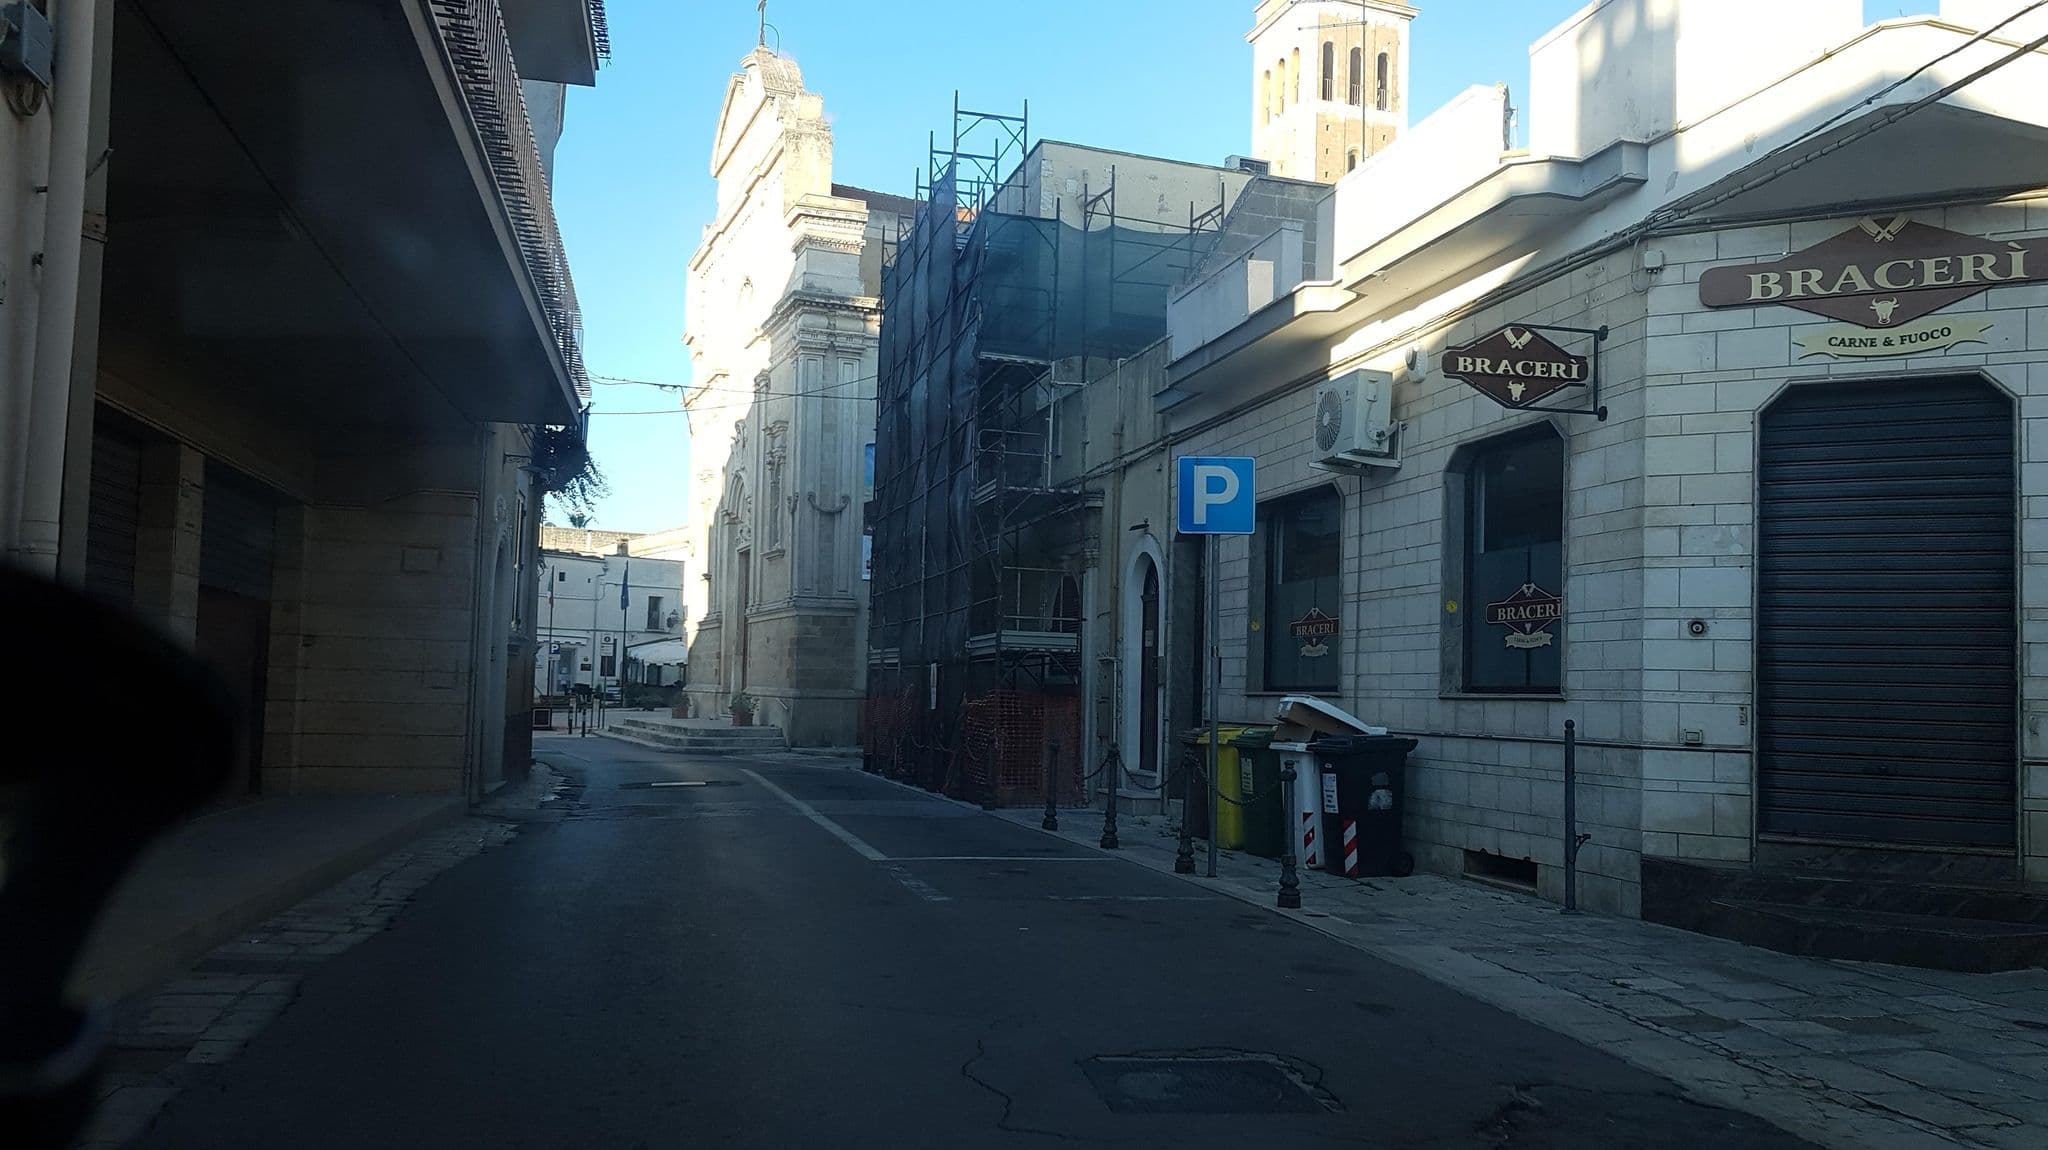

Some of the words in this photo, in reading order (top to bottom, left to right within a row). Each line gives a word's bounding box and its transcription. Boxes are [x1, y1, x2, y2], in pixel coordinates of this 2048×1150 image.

[1746, 241, 2030, 301] BRACERÌ
[1828, 336, 1877, 348] CARNE
[1882, 336, 1895, 347] &
[1899, 326, 1951, 345] FUOCO
[1456, 356, 1581, 379] BRACERÌ
[1193, 465, 1239, 525] P
[551, 644, 559, 653] P
